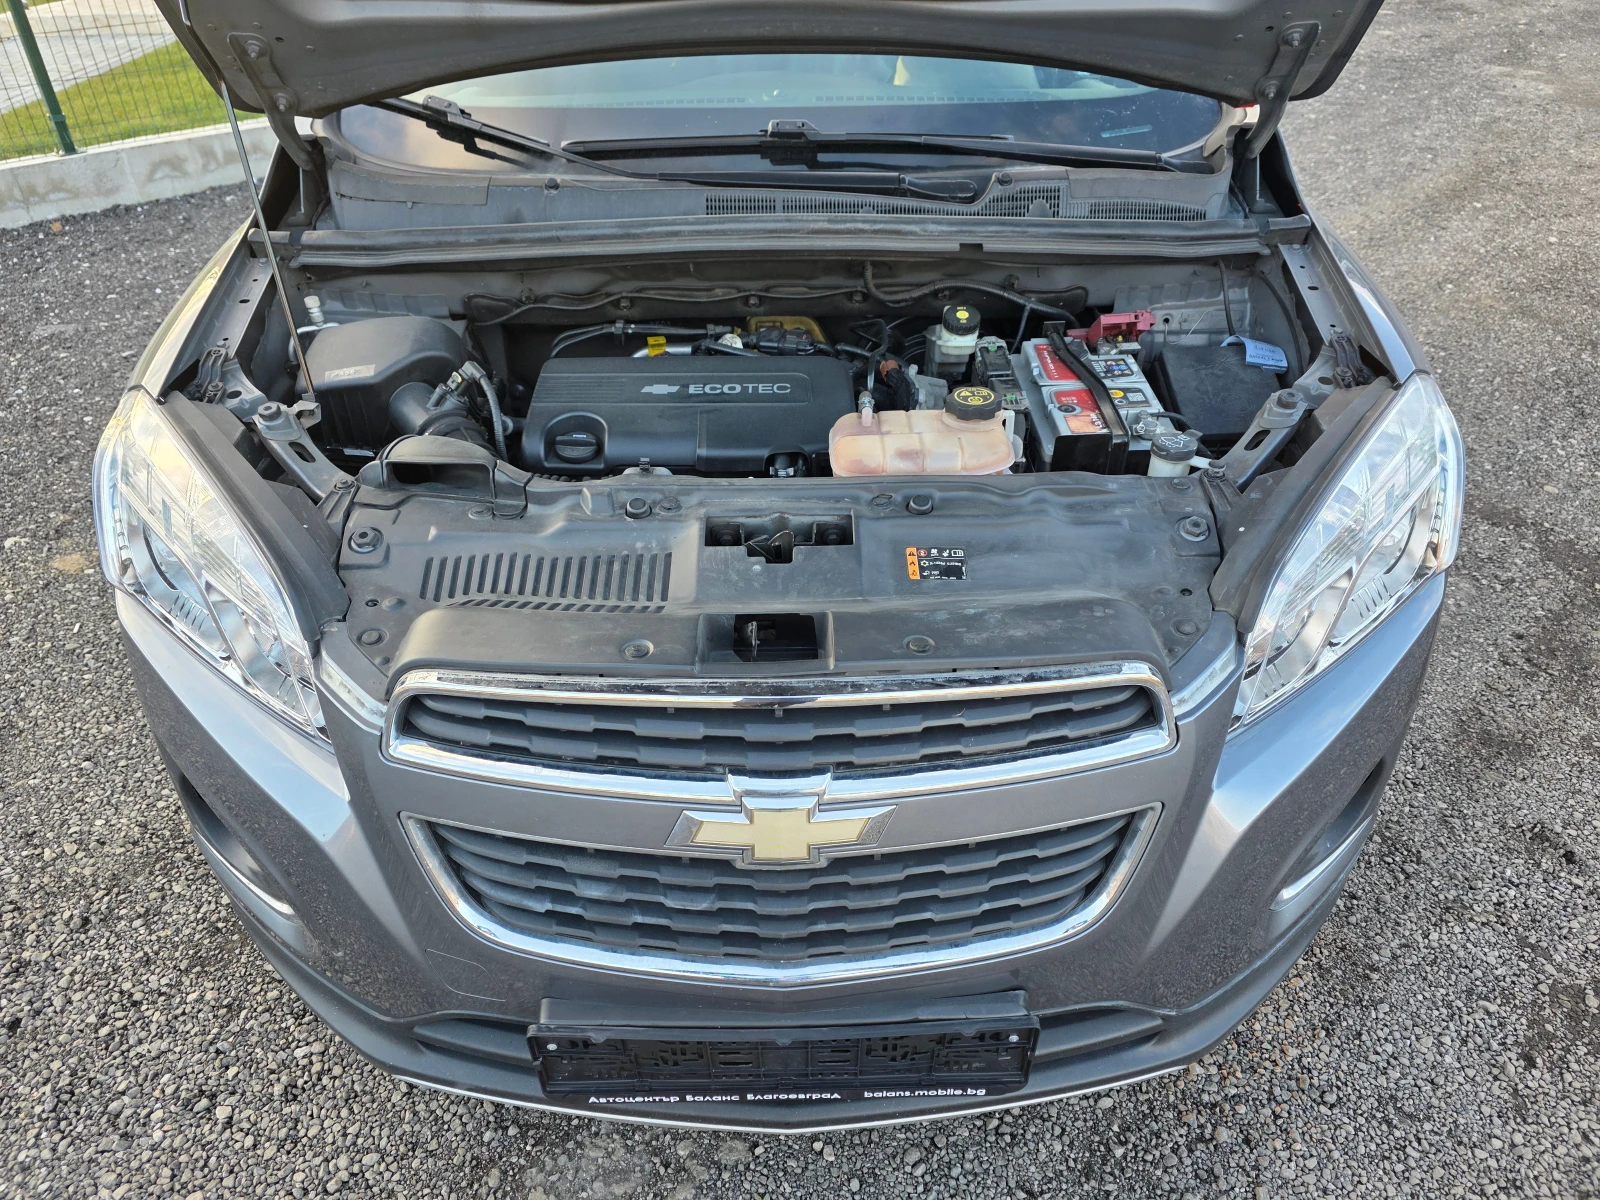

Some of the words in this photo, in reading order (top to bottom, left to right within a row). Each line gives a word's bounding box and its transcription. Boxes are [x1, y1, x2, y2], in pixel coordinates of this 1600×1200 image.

[688, 383, 791, 394] ECOTEC
[863, 1088, 986, 1098] balans.mobile.bg
[588, 1095, 680, 1103] Автоцентър
[685, 1094, 740, 1102] Баланс
